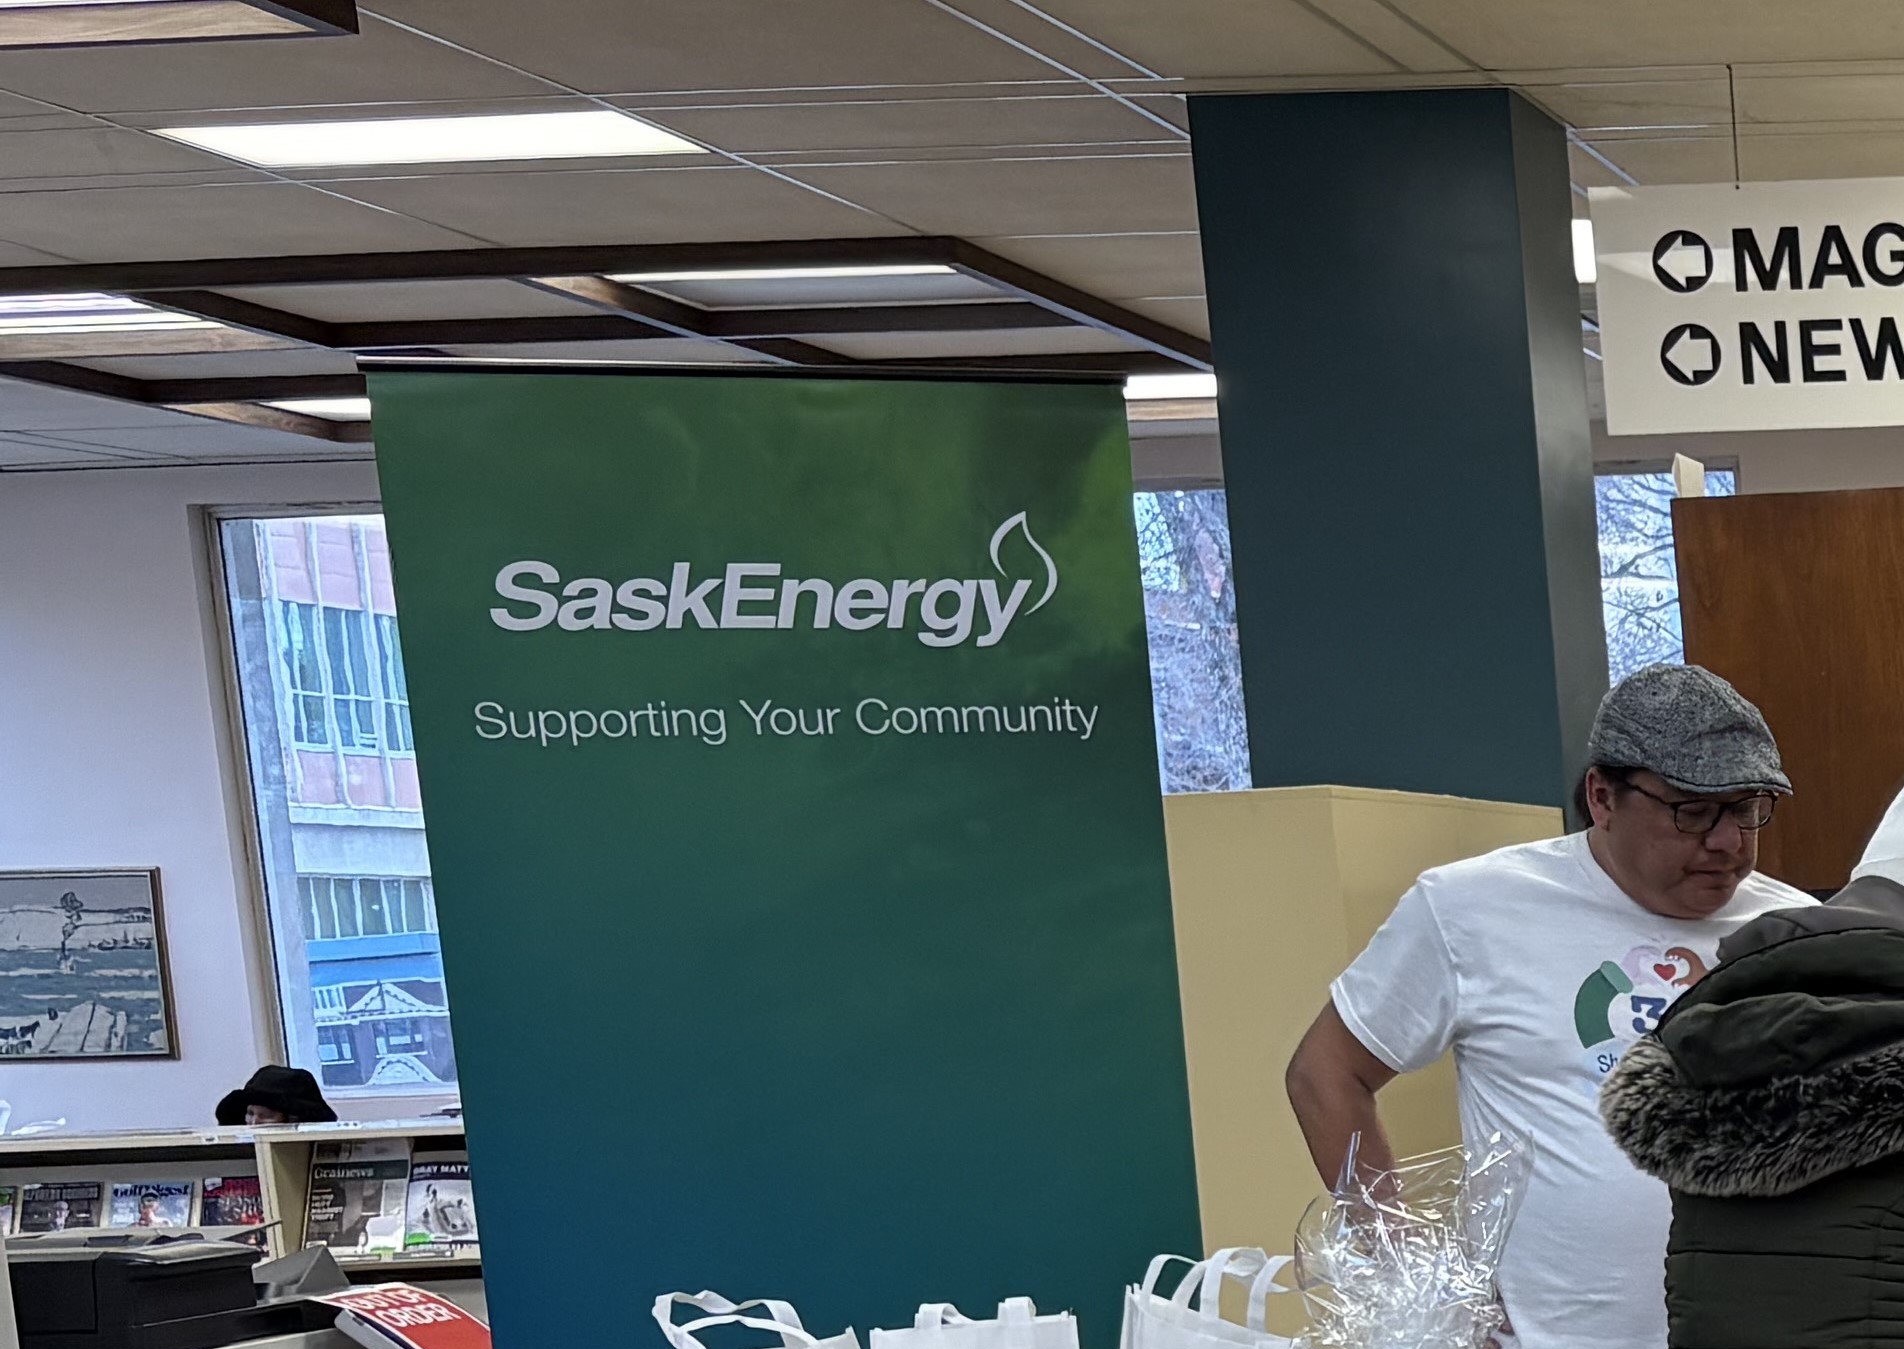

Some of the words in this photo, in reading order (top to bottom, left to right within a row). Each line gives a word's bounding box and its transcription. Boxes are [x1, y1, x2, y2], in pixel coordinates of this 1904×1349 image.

[490, 560, 1032, 648] SaskEnergy
[474, 701, 727, 747] Supporting
[739, 699, 842, 736] Your
[855, 697, 1099, 741] Community
[1630, 995, 1667, 1034] 3
[374, 1302, 462, 1328] ORDER
